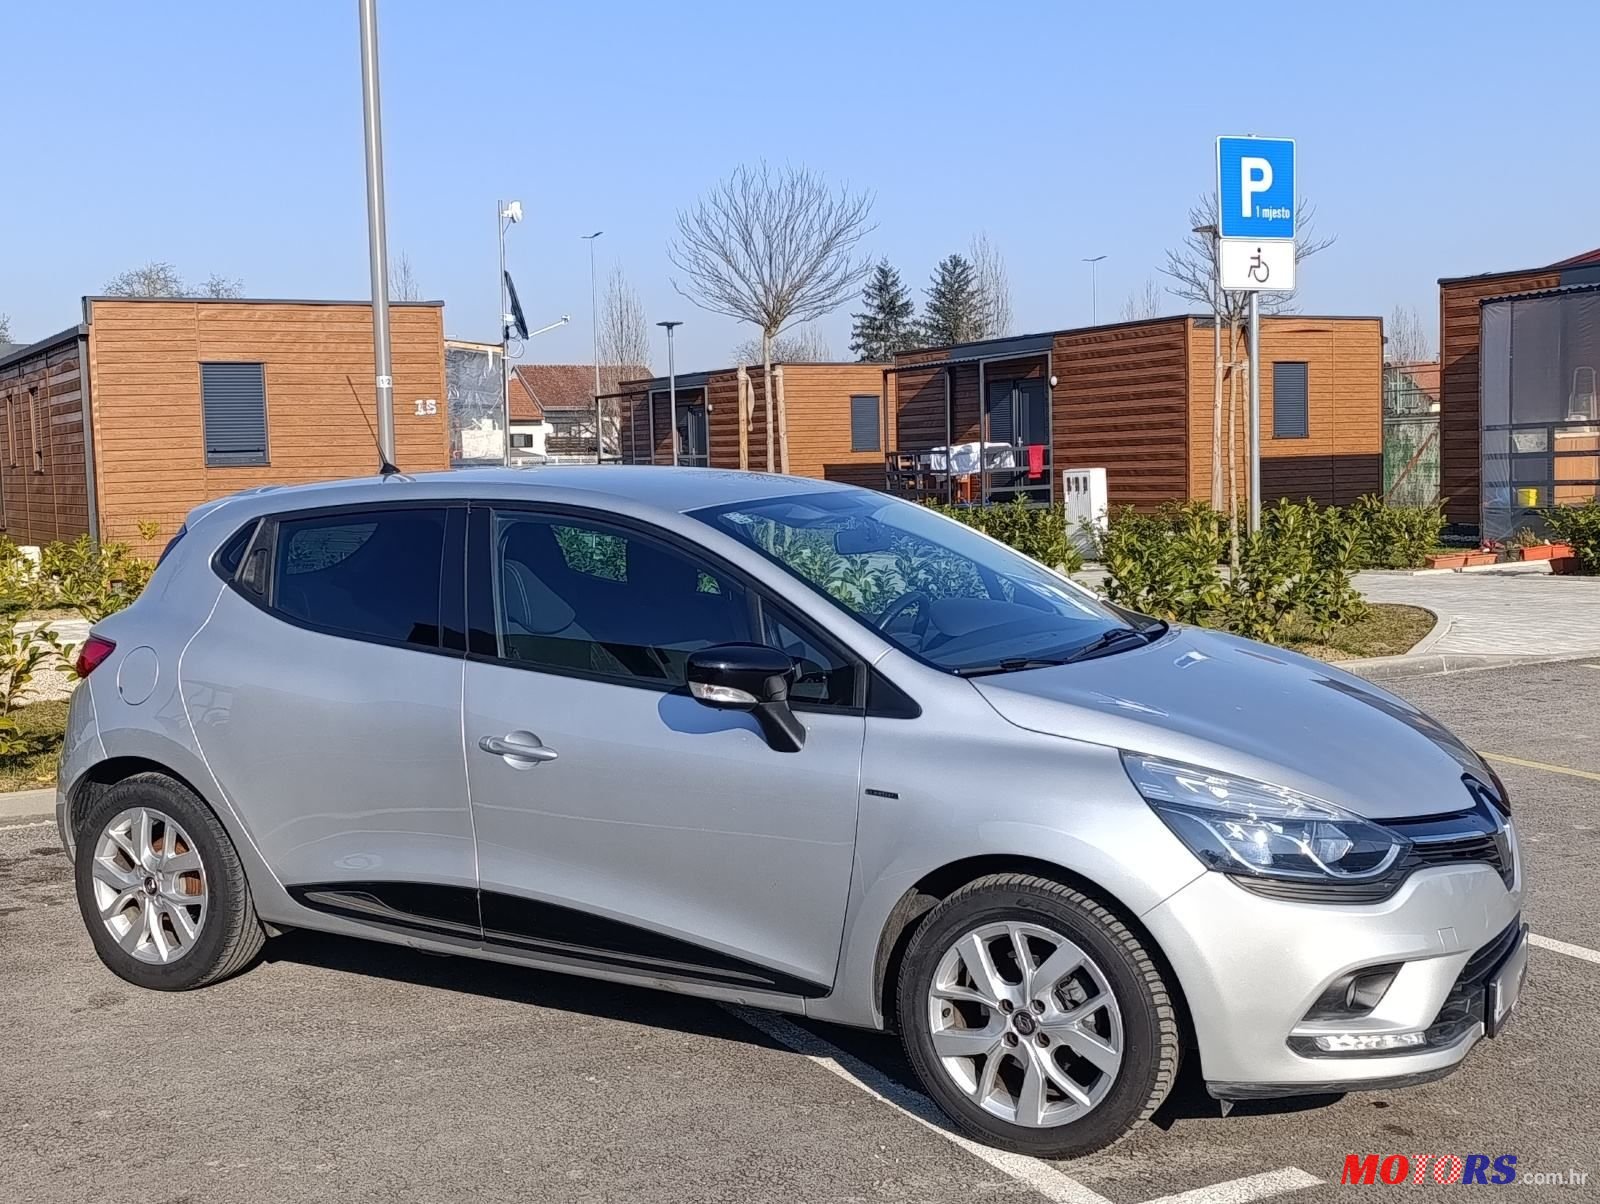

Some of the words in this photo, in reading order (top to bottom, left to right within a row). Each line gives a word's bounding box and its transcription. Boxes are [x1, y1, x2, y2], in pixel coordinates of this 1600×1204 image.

[1241, 156, 1273, 218] P
[1256, 205, 1260, 218] 1
[1262, 206, 1291, 222] mjesto
